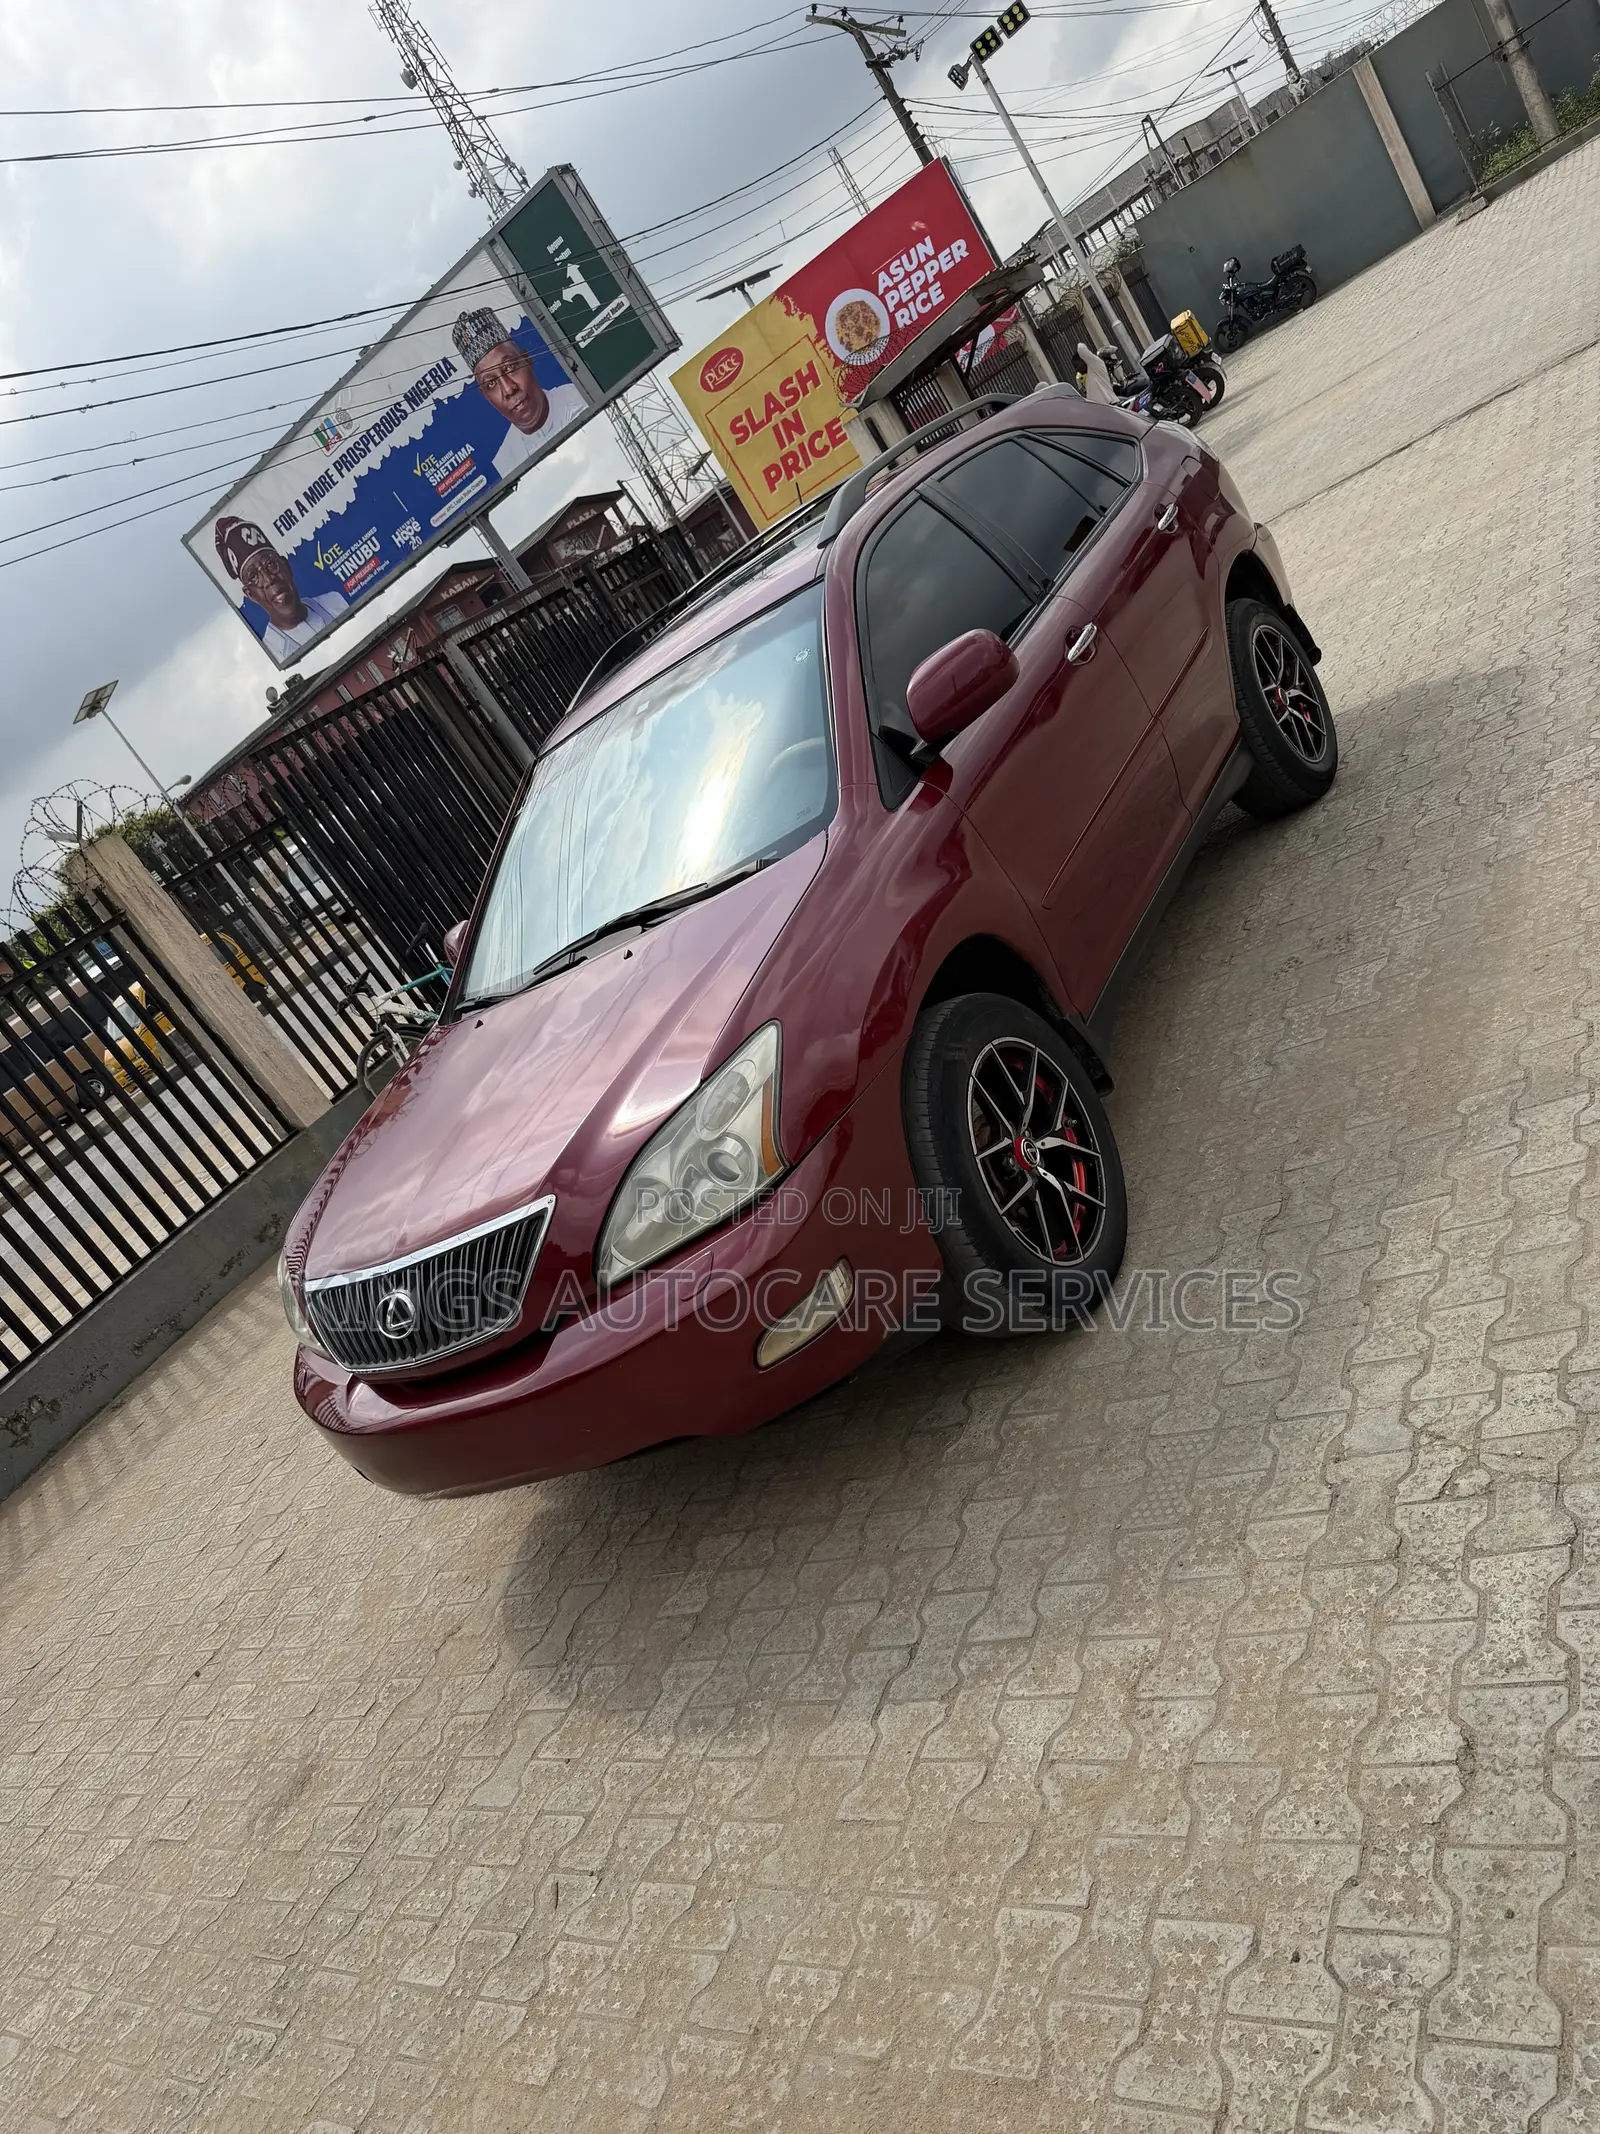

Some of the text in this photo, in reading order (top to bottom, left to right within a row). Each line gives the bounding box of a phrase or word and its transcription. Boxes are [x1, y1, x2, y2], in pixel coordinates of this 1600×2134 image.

[877, 235, 936, 296] ASUN
[884, 238, 969, 313] PEPPER
[894, 280, 945, 329] RICE
[729, 359, 822, 446] SLASH
[273, 357, 458, 537] FOR A MORE PROSPEROUS NIGERIA
[772, 410, 806, 451] IN
[428, 442, 475, 485] SHETTIMA
[761, 417, 849, 495] PRICE
[566, 508, 598, 529] PLAZA
[334, 536, 381, 582] TINUBU
[440, 575, 480, 600] KASAM
